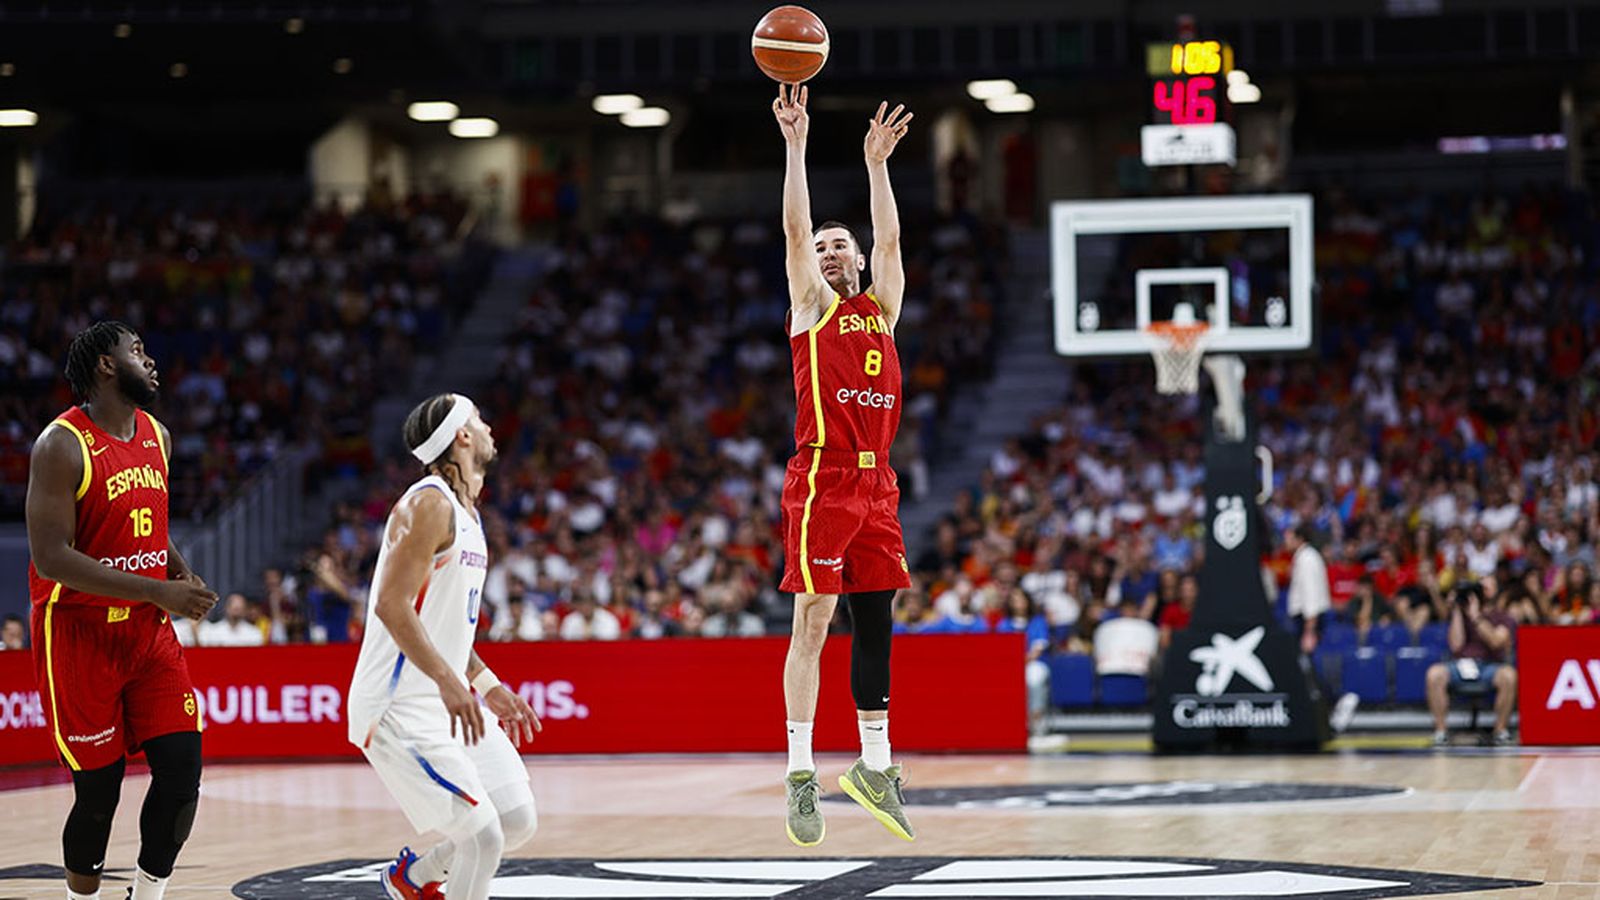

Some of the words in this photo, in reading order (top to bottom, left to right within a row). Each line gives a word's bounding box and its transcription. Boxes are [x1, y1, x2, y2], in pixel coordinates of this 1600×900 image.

[864, 349, 882, 376] 8
[106, 464, 167, 501] ESPAÑA
[129, 507, 153, 538] 16
